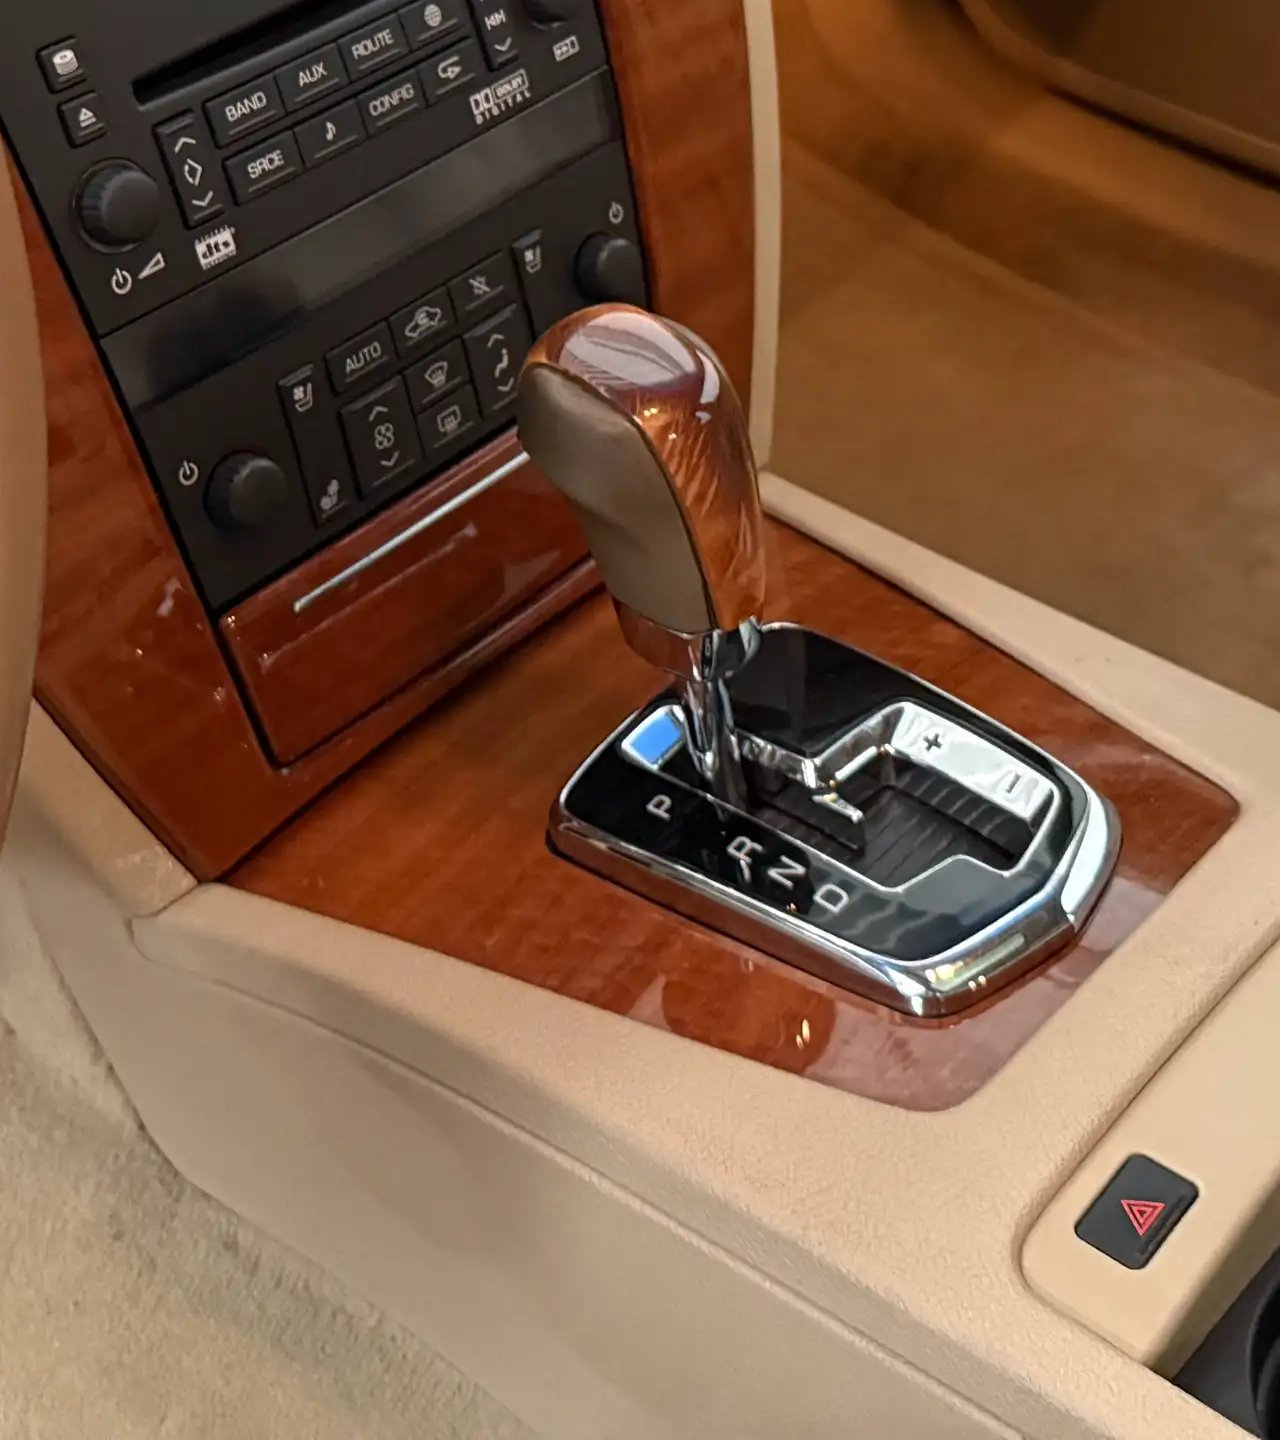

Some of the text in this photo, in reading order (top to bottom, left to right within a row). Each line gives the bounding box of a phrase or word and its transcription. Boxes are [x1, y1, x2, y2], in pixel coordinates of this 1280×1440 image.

[351, 28, 395, 60] ROUTE
[298, 62, 328, 88] AUX
[224, 91, 268, 123] BAND
[370, 82, 415, 117] CONFIG
[474, 89, 532, 125] DIGITAL
[247, 150, 285, 179] SRCE
[345, 341, 382, 375] AUTO
[646, 794, 850, 914] P R N D
